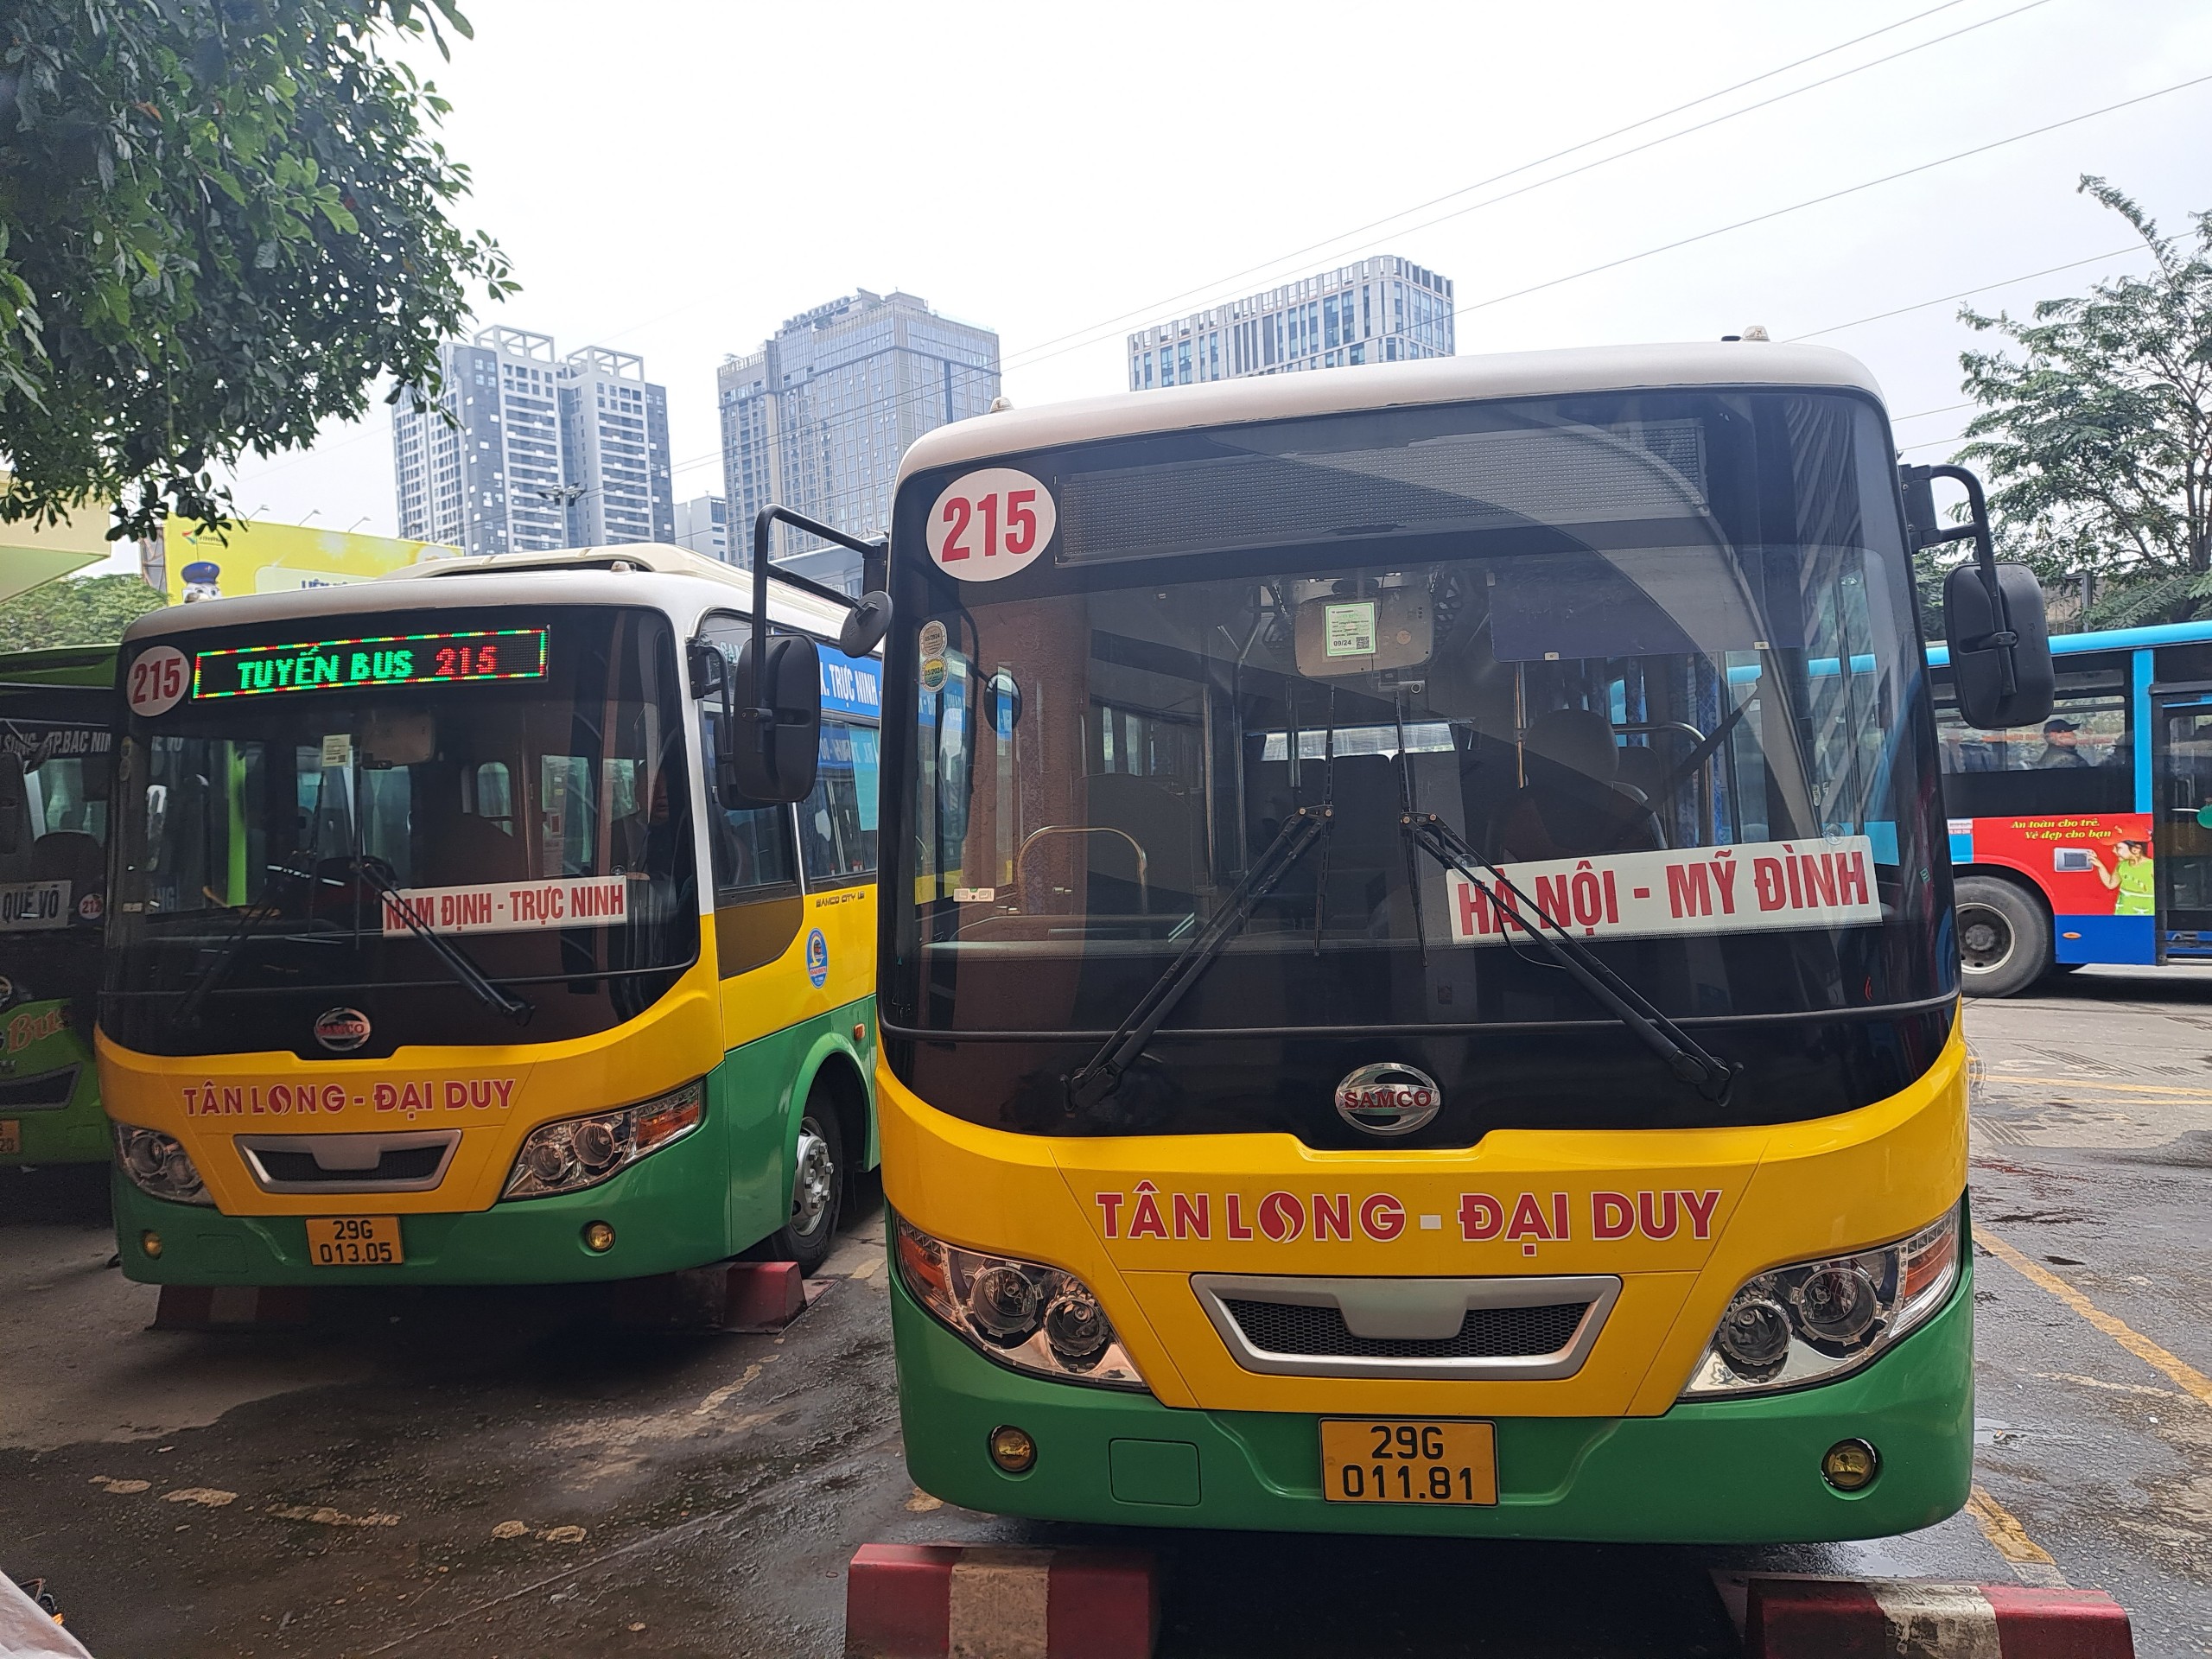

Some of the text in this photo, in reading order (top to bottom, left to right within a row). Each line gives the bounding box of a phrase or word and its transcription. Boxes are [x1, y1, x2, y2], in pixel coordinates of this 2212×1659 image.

[942, 489, 1036, 563] 215
[132, 658, 181, 704] 215
[238, 645, 499, 690] TUYẾN BUS 215
[829, 664, 855, 708] TRỰC
[855, 671, 879, 706] NINH
[386, 897, 435, 931] NAM
[441, 893, 492, 931] ĐỊNH
[510, 885, 564, 925] TRỰC
[571, 884, 624, 918] NINH
[1458, 868, 1518, 936] HÀ
[1535, 860, 1620, 936] NỘI
[1665, 849, 1738, 918] MỸ
[1754, 844, 1870, 912] ĐÌNH
[182, 1079, 244, 1116] TÂN
[251, 1083, 346, 1116] LONG
[373, 1081, 434, 1121] ĐẠI
[444, 1078, 517, 1110] DUY
[1344, 1090, 1432, 1110] SAMCO
[333, 1219, 373, 1240] 29G
[1096, 1179, 1211, 1241] TÂN
[1226, 1191, 1407, 1244] LONG
[1459, 1191, 1572, 1257] ĐẠI
[1591, 1189, 1723, 1242] DUY
[319, 1242, 393, 1263] 013.05
[1370, 1426, 1444, 1460] 29G
[1342, 1465, 1473, 1501] 011.81
